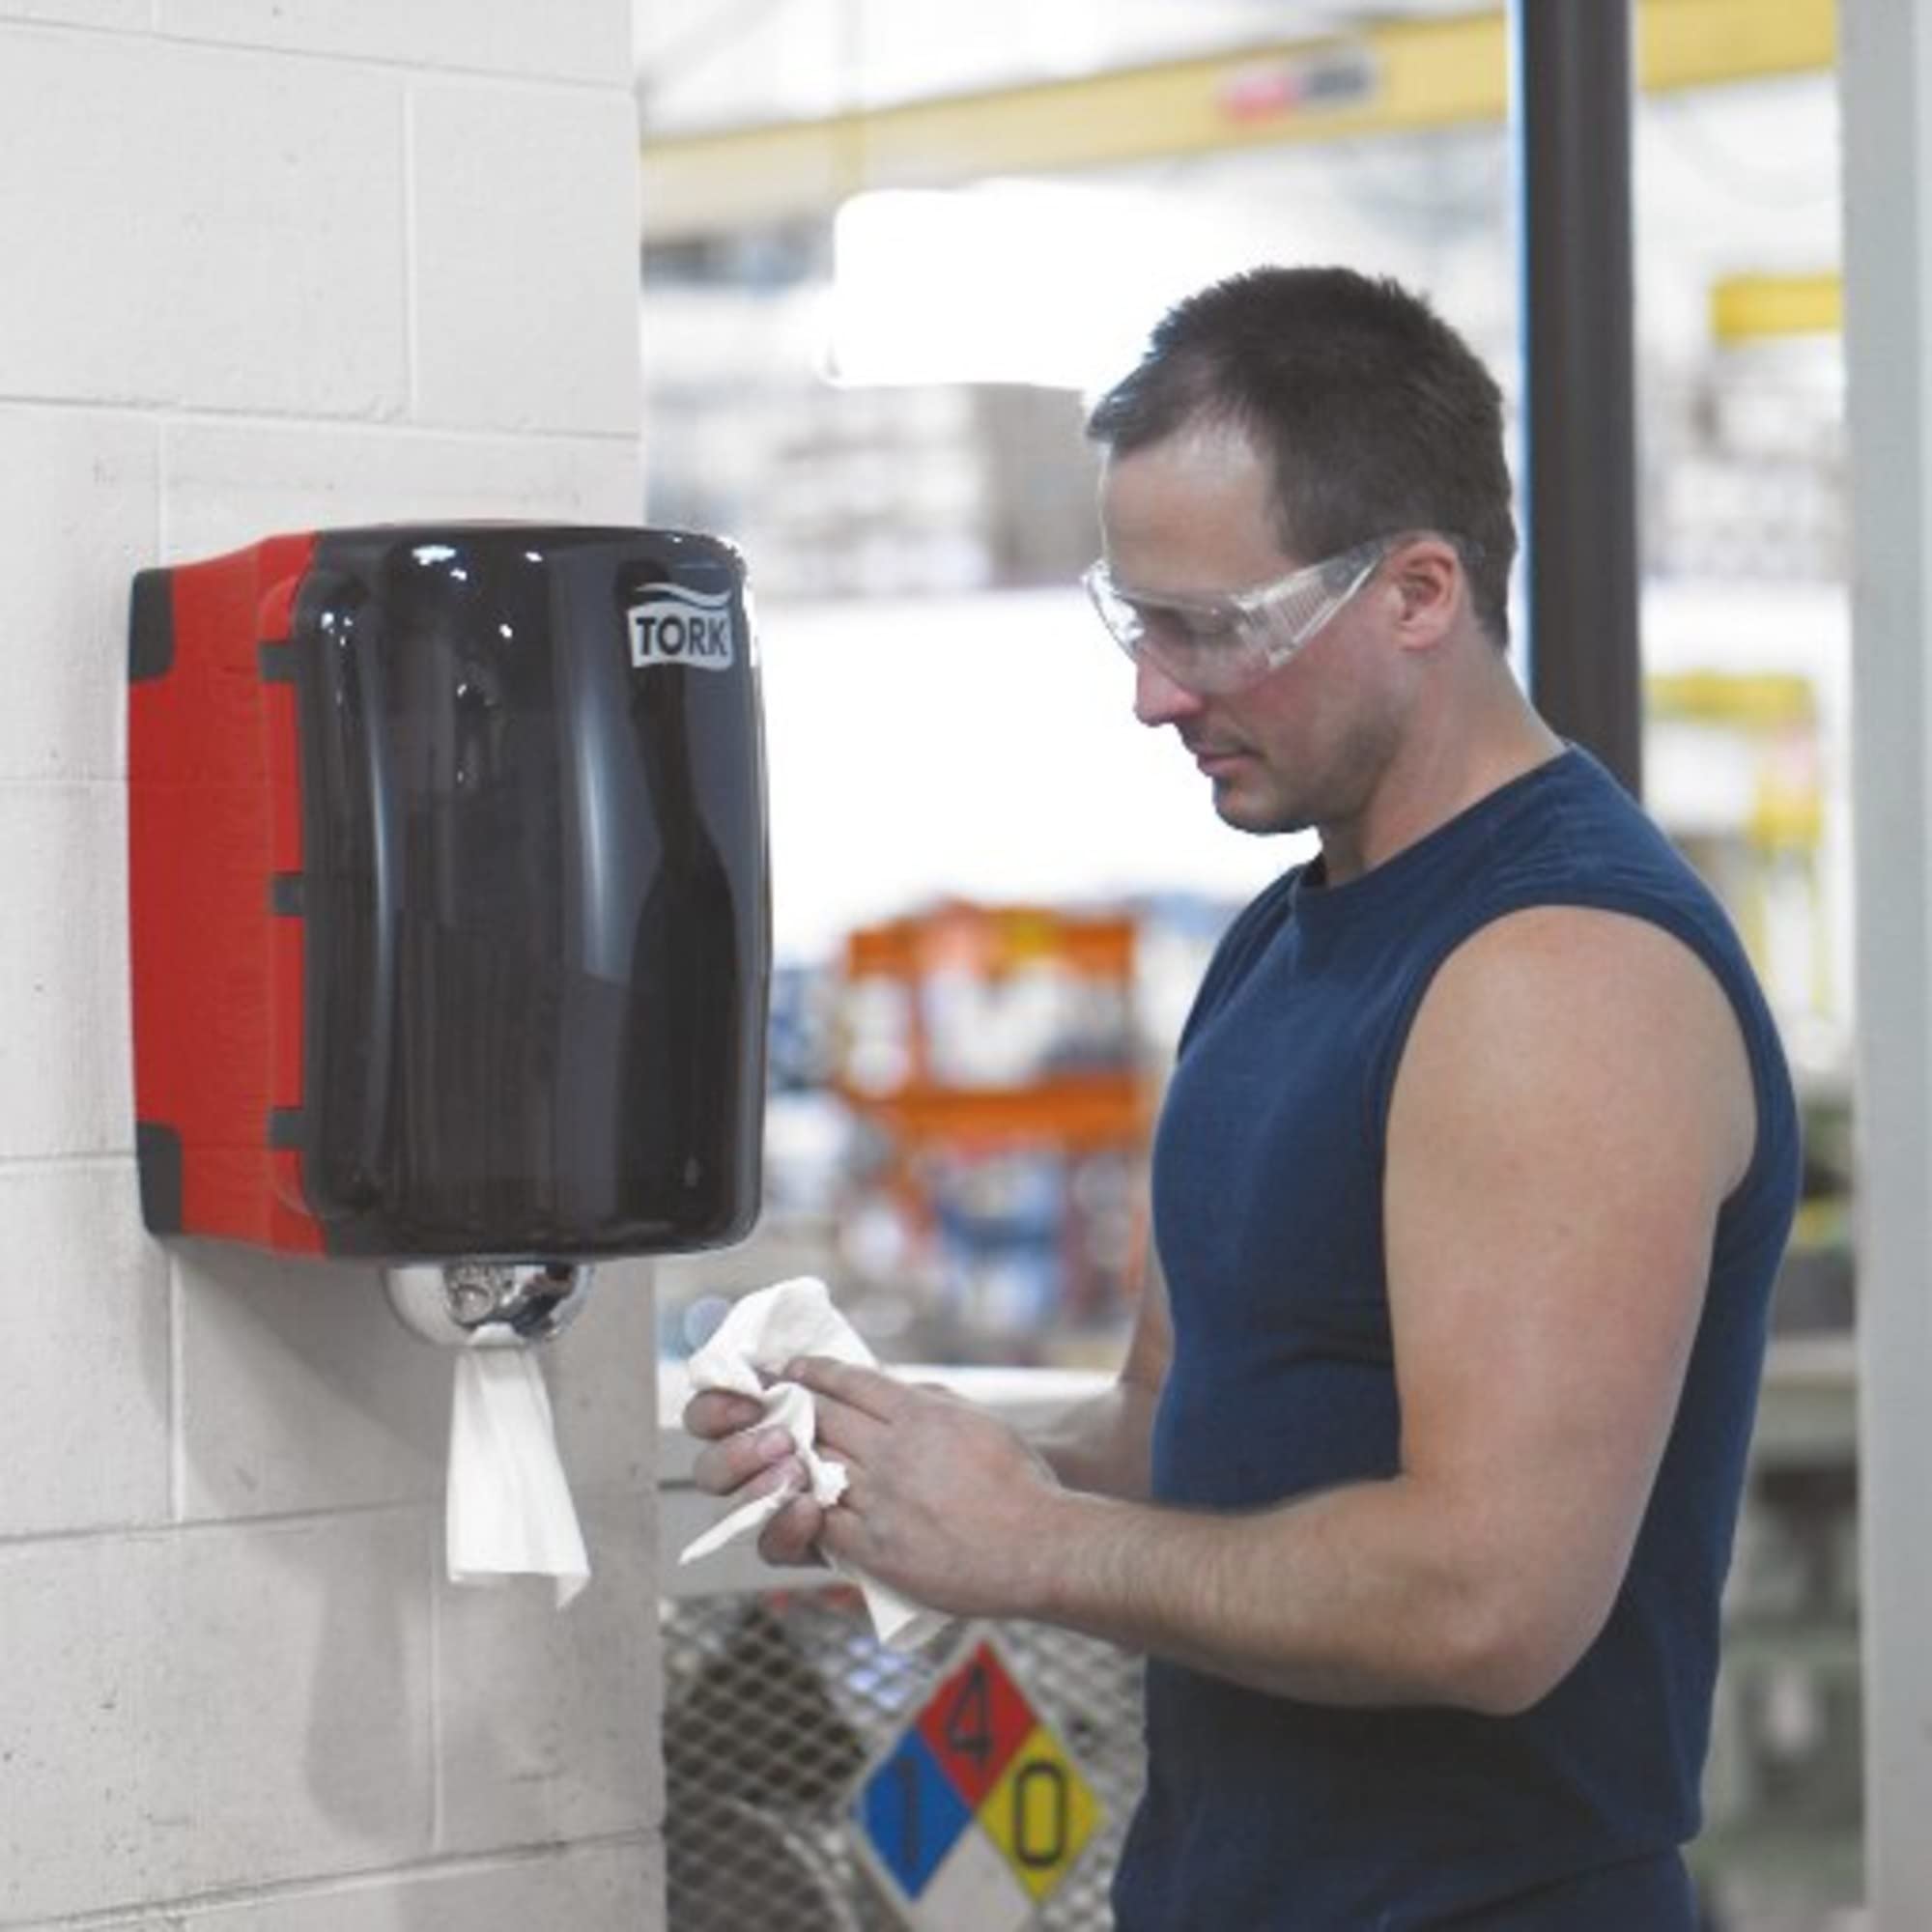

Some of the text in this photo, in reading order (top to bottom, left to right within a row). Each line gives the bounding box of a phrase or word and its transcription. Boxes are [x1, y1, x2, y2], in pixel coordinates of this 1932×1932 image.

[636, 615, 727, 657] TORK
[945, 1662, 994, 1768] 4
[896, 1754, 919, 1868] 1
[1013, 1759, 1067, 1870] 0
